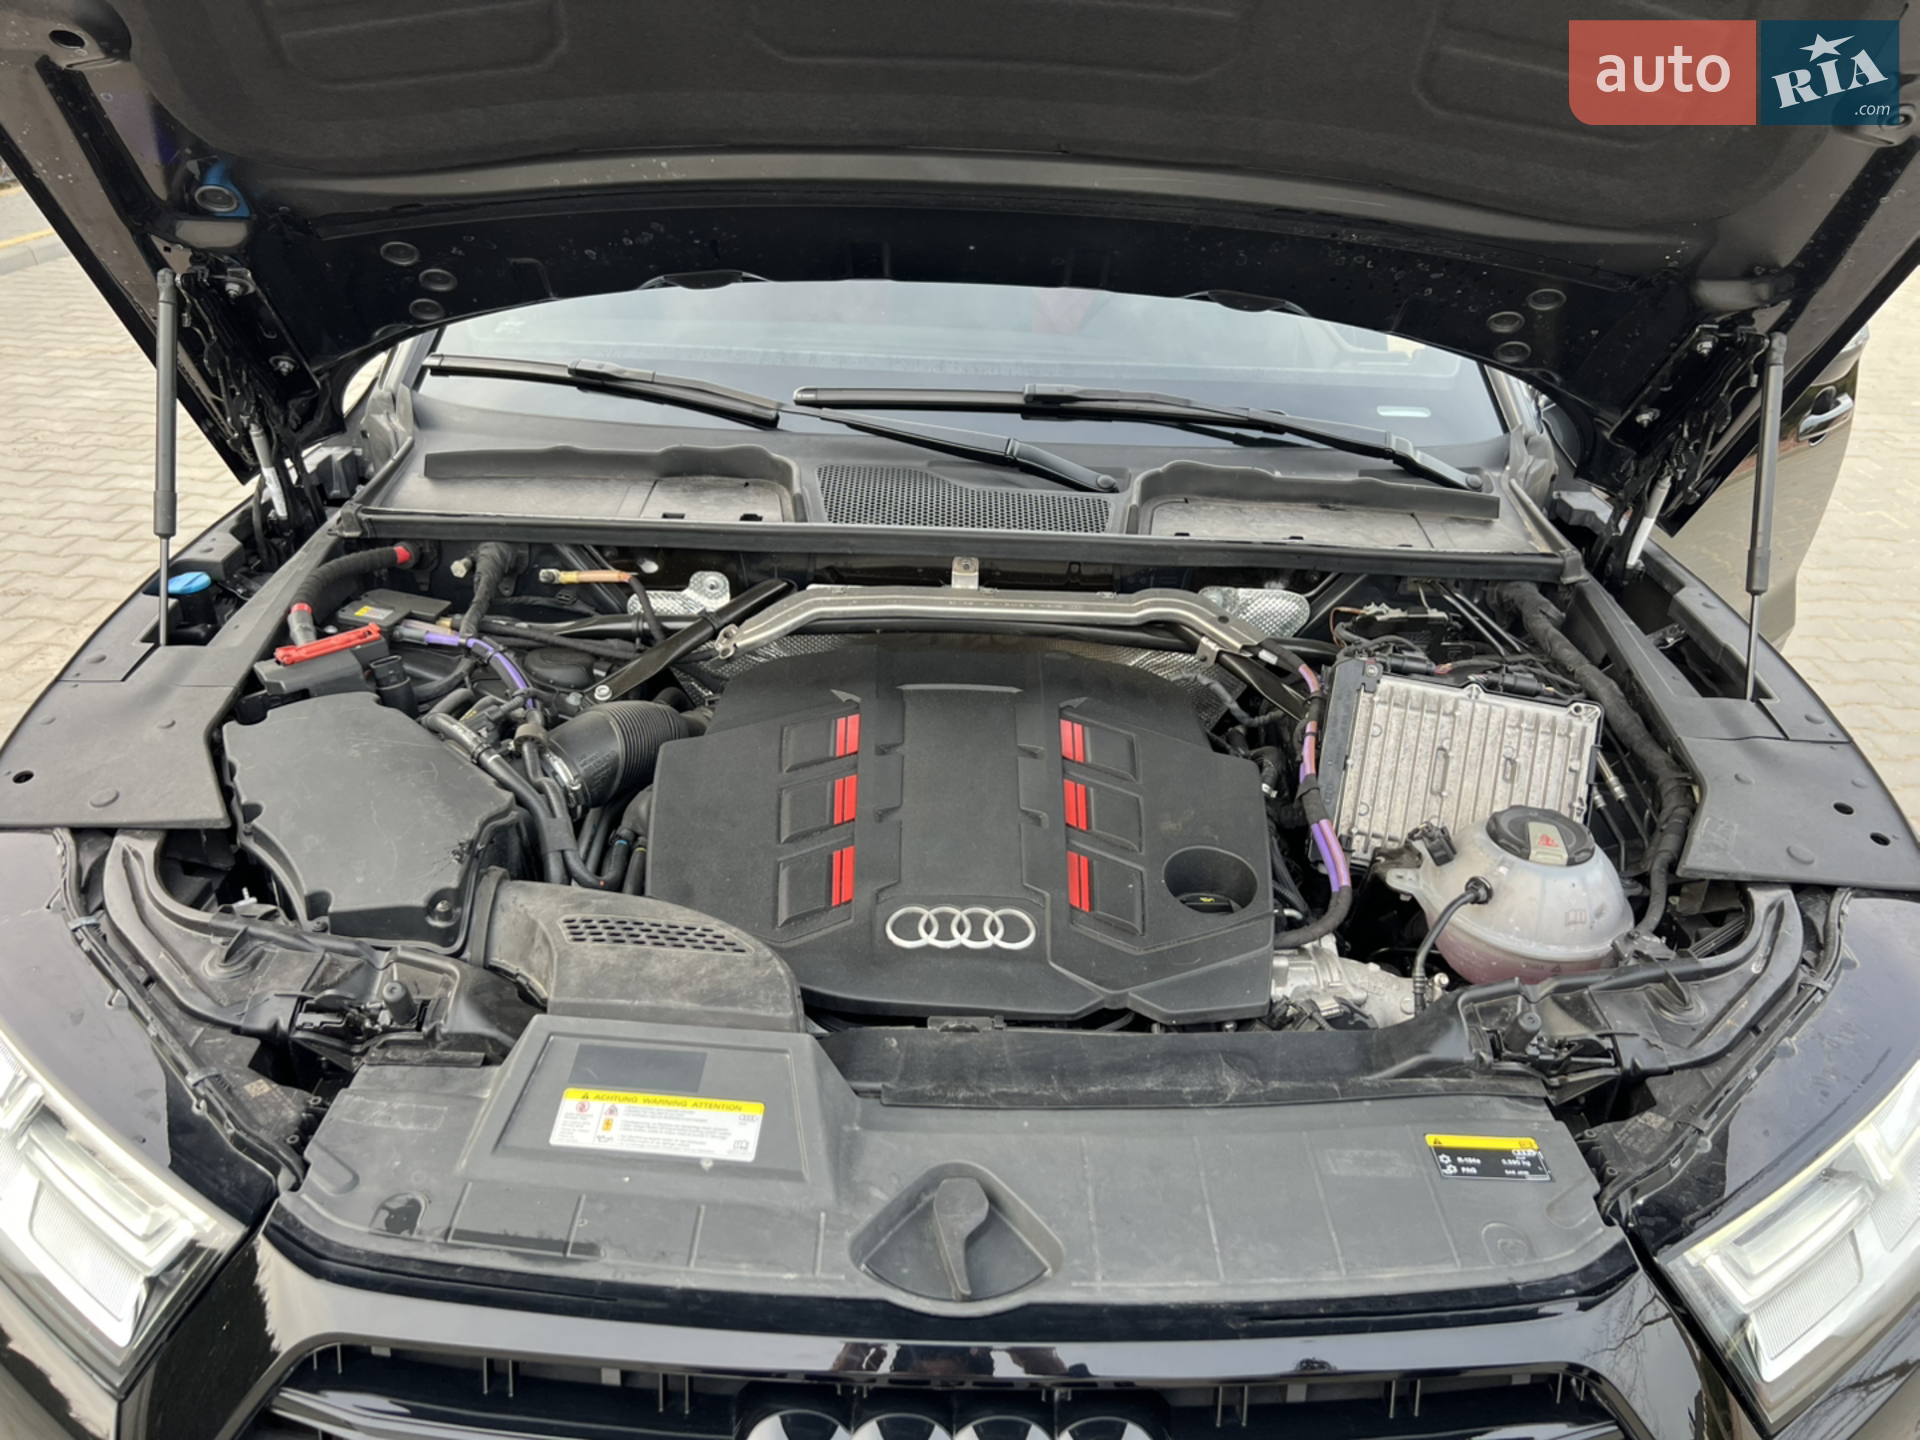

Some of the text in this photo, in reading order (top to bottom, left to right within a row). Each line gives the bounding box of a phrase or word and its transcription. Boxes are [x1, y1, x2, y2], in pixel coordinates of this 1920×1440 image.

[593, 1093, 742, 1112] ACHTUNG WARNING ATTENTION
